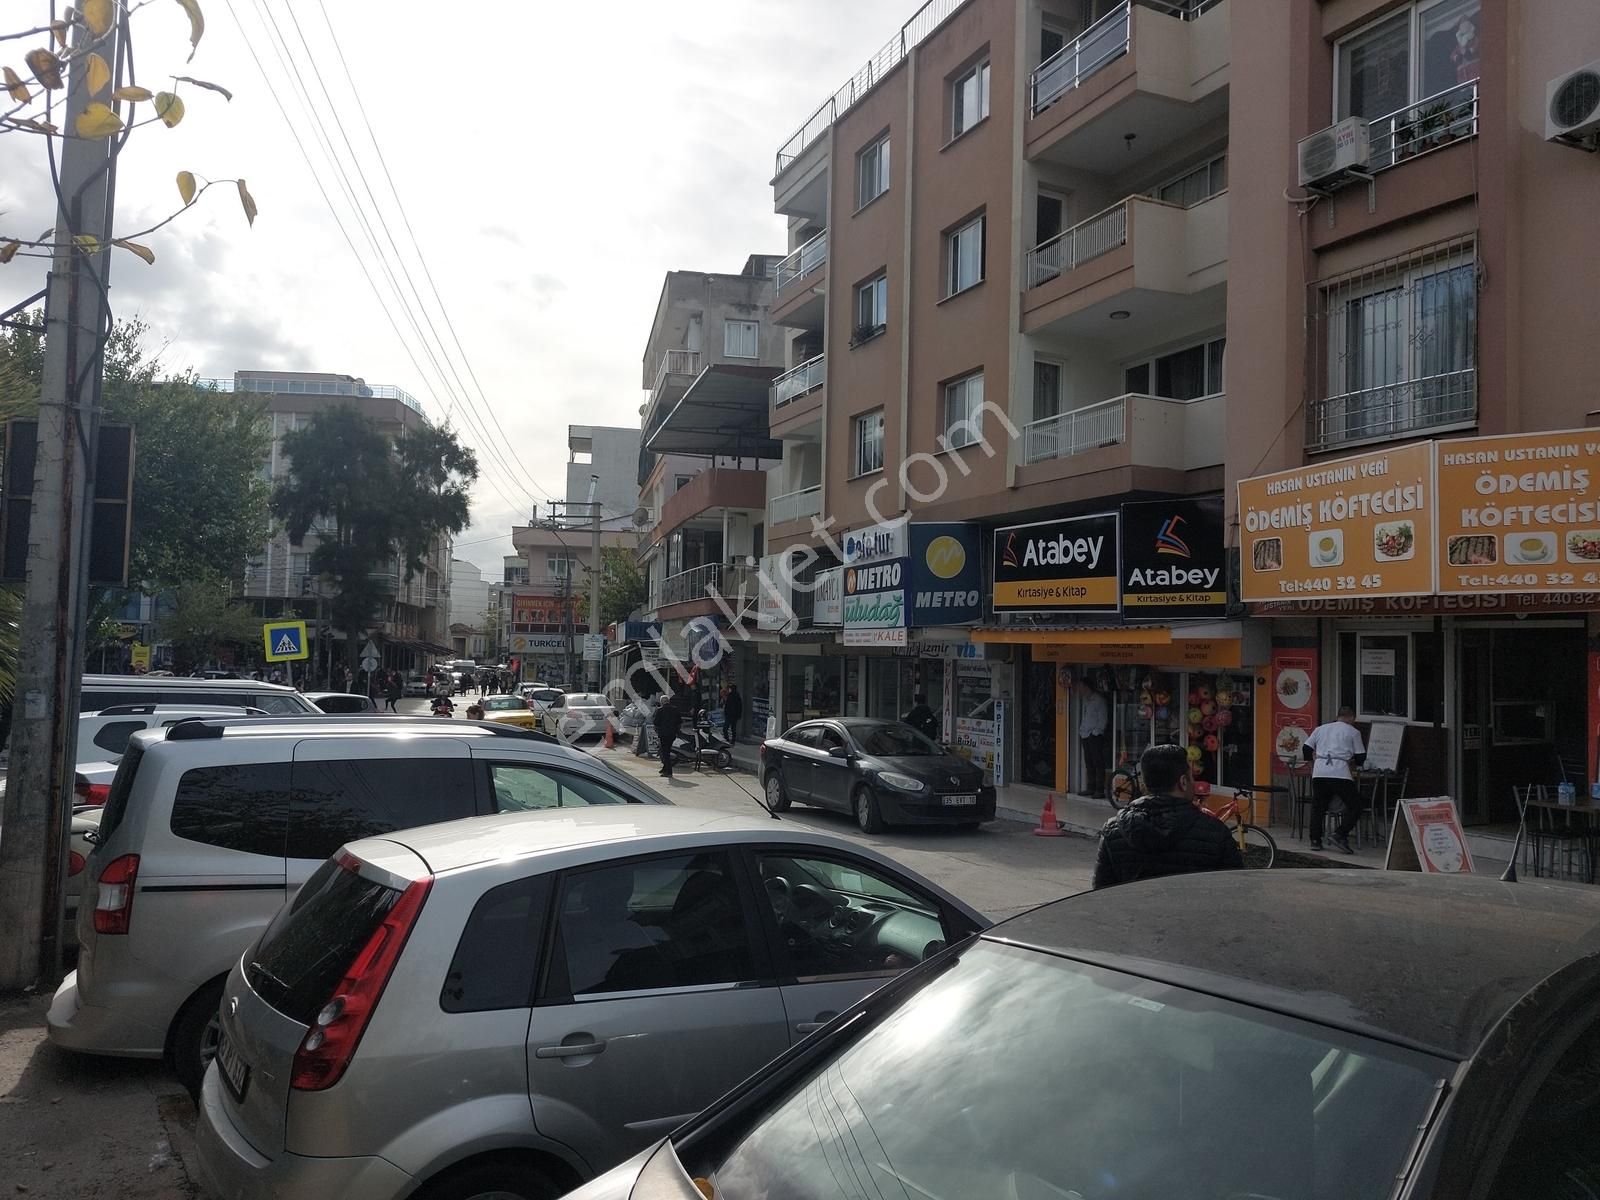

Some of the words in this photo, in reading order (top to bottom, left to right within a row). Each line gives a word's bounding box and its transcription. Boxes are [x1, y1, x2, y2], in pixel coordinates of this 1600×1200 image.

[1443, 450, 1499, 466] HASAN
[1504, 444, 1579, 462] USTANIN
[1266, 477, 1303, 497] HASAN
[1306, 465, 1356, 488] USTANIN
[1360, 455, 1389, 478] YERİ
[1474, 464, 1590, 496] ÖDEMİŞ
[1245, 497, 1314, 532] ÖDEMİŞ
[1319, 476, 1424, 523] KÖFTECİSİ
[1022, 533, 1104, 570] Atabey
[857, 562, 902, 591] METRO
[1127, 565, 1220, 589] Atabey
[1336, 576, 1356, 591] 32
[1361, 573, 1383, 589] 45
[1545, 572, 1576, 585] 32
[1582, 571, 1600, 585] 4
[915, 590, 980, 608] METRO
[1055, 586, 1062, 598] &
[529, 639, 571, 649] TURKCEL
[879, 631, 904, 642] KALE
